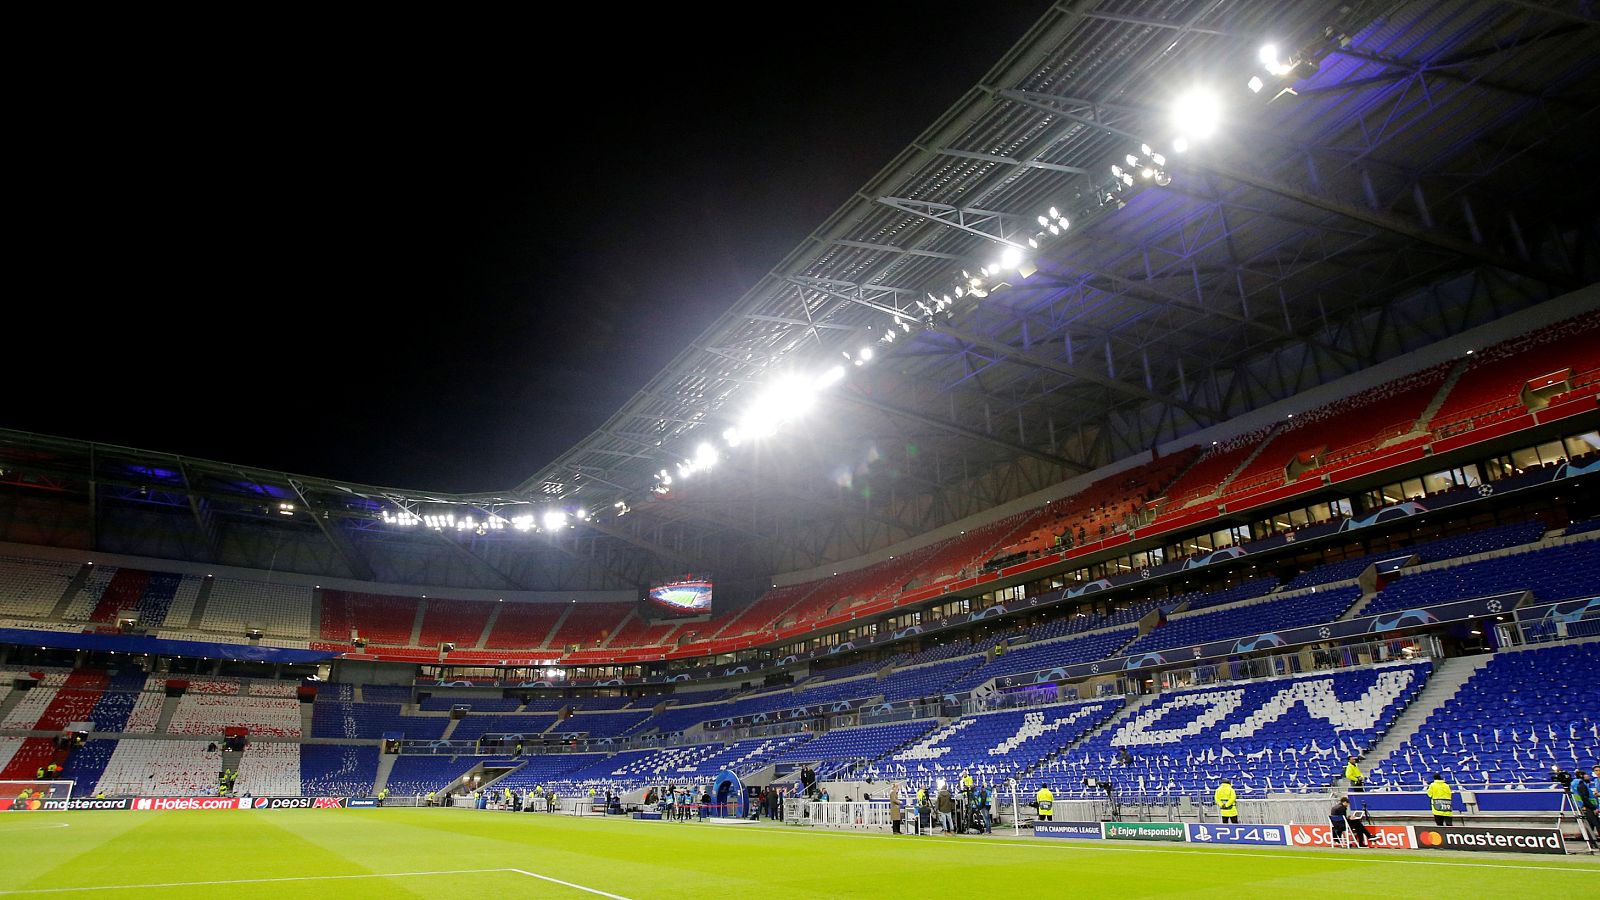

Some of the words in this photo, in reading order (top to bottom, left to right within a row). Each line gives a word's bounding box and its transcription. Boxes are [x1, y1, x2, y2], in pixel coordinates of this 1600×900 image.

[44, 798, 126, 810] mastercard
[154, 798, 233, 810] Hotels.com
[271, 797, 311, 809] pepsi
[312, 797, 345, 809] MAX
[1118, 826, 1137, 837] Enjoy
[1138, 827, 1183, 838] Responsibly
[1215, 827, 1261, 841] PS4
[1266, 831, 1278, 839] Pro
[1446, 832, 1560, 849] mastercard
